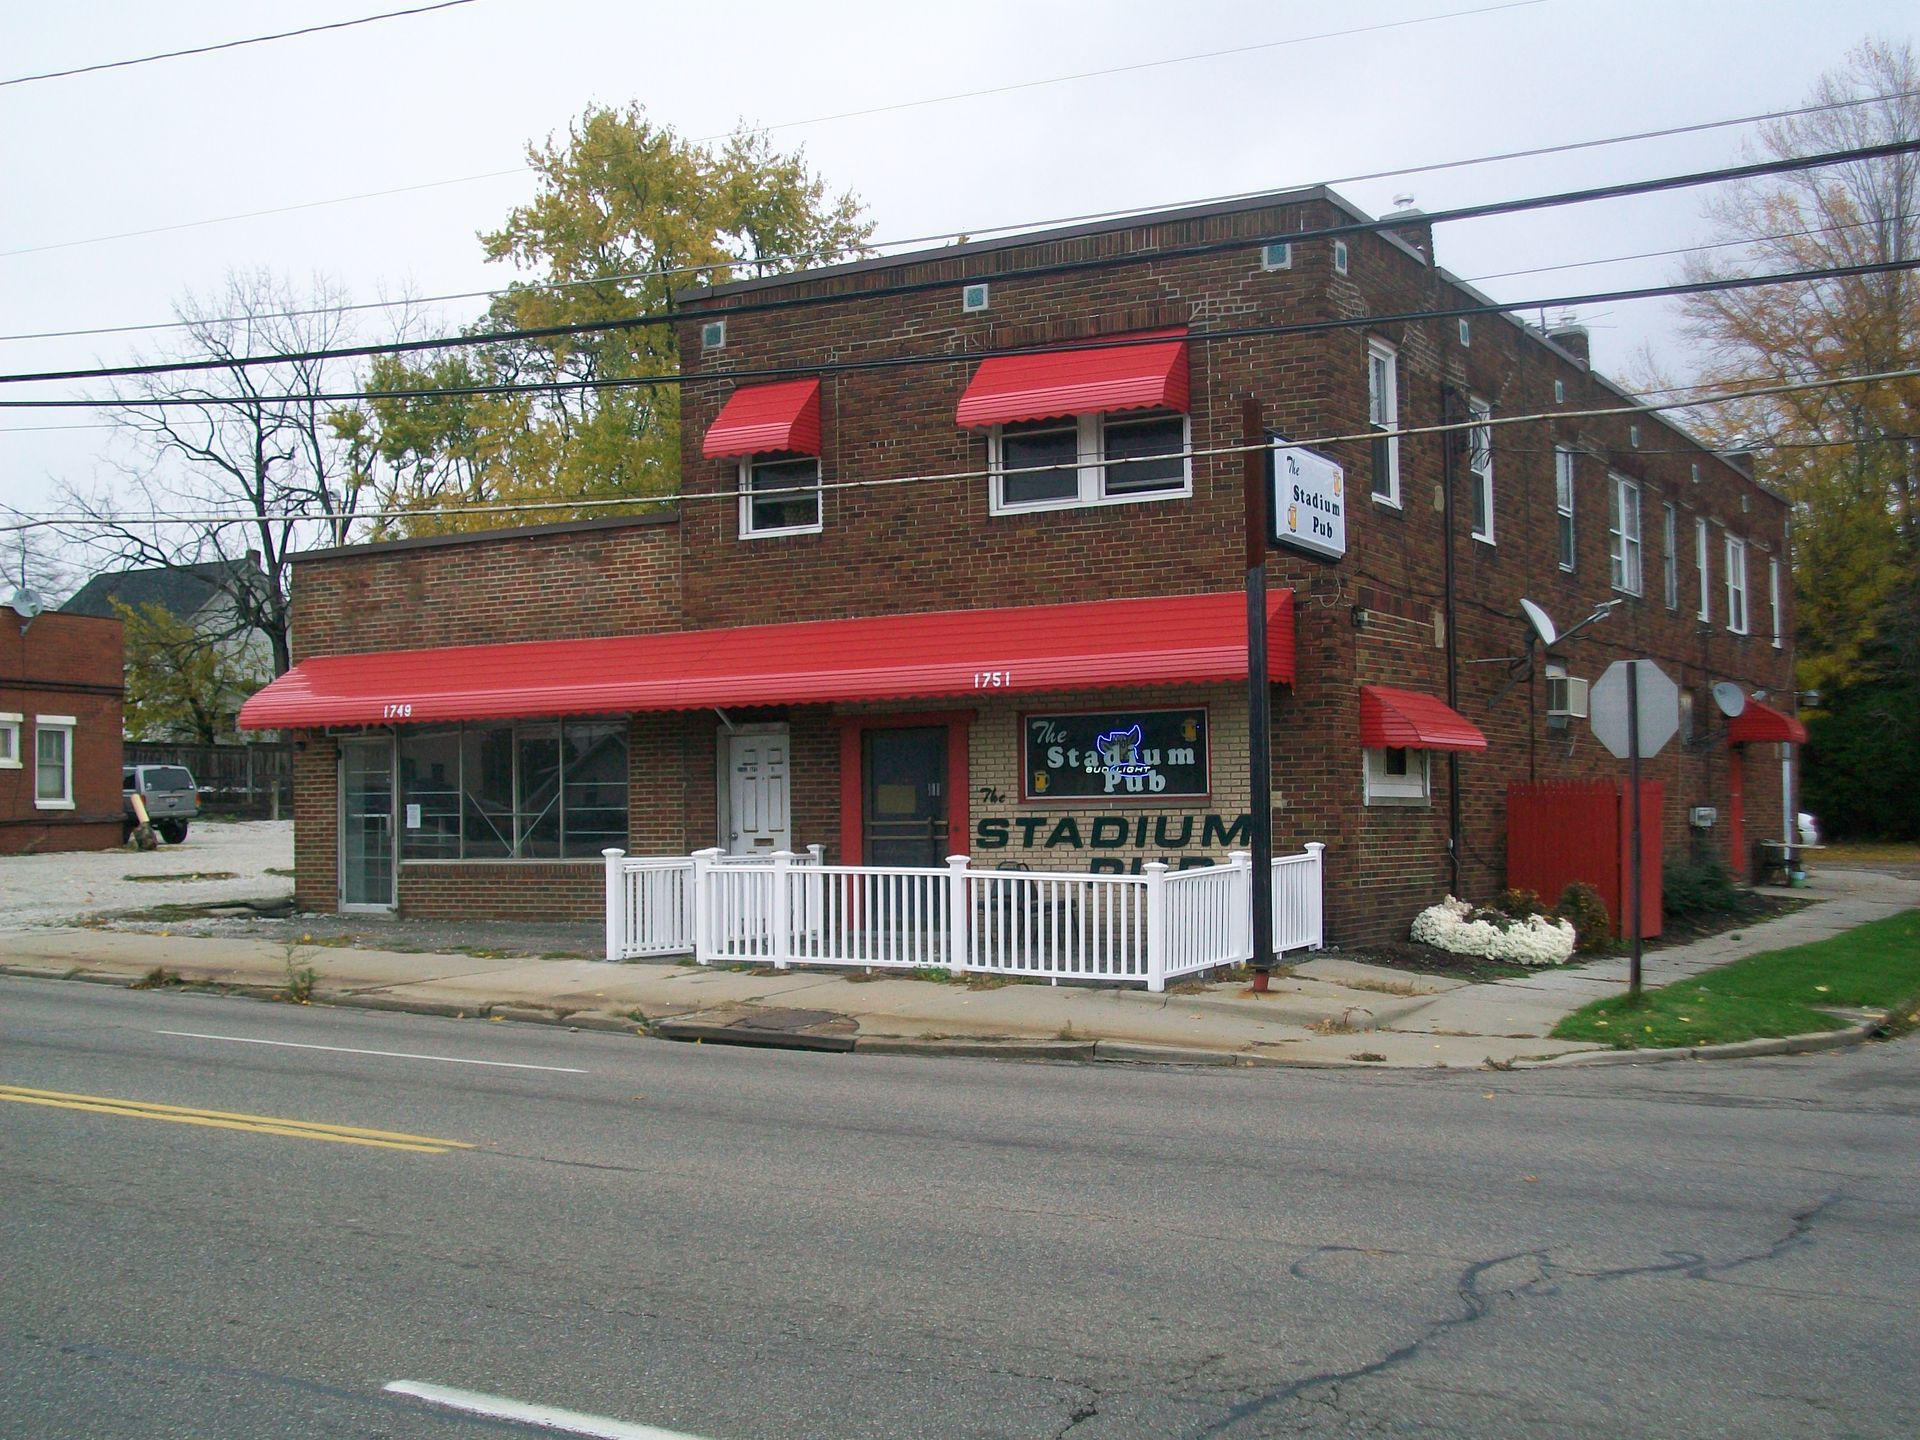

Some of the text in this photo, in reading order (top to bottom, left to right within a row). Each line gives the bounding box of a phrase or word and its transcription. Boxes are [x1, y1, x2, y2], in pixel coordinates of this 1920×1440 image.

[1287, 456, 1300, 476] The
[1293, 484, 1340, 517] Stadium
[1313, 516, 1333, 539] Pub
[974, 671, 1010, 689] 1751
[384, 704, 412, 719] 1749
[1031, 721, 1068, 744] The
[1047, 744, 1195, 769] Stadium
[1103, 770, 1166, 793] Pub
[1117, 766, 1151, 774] LIGHT
[980, 785, 1006, 803] The
[975, 814, 1252, 849] STADIUM
